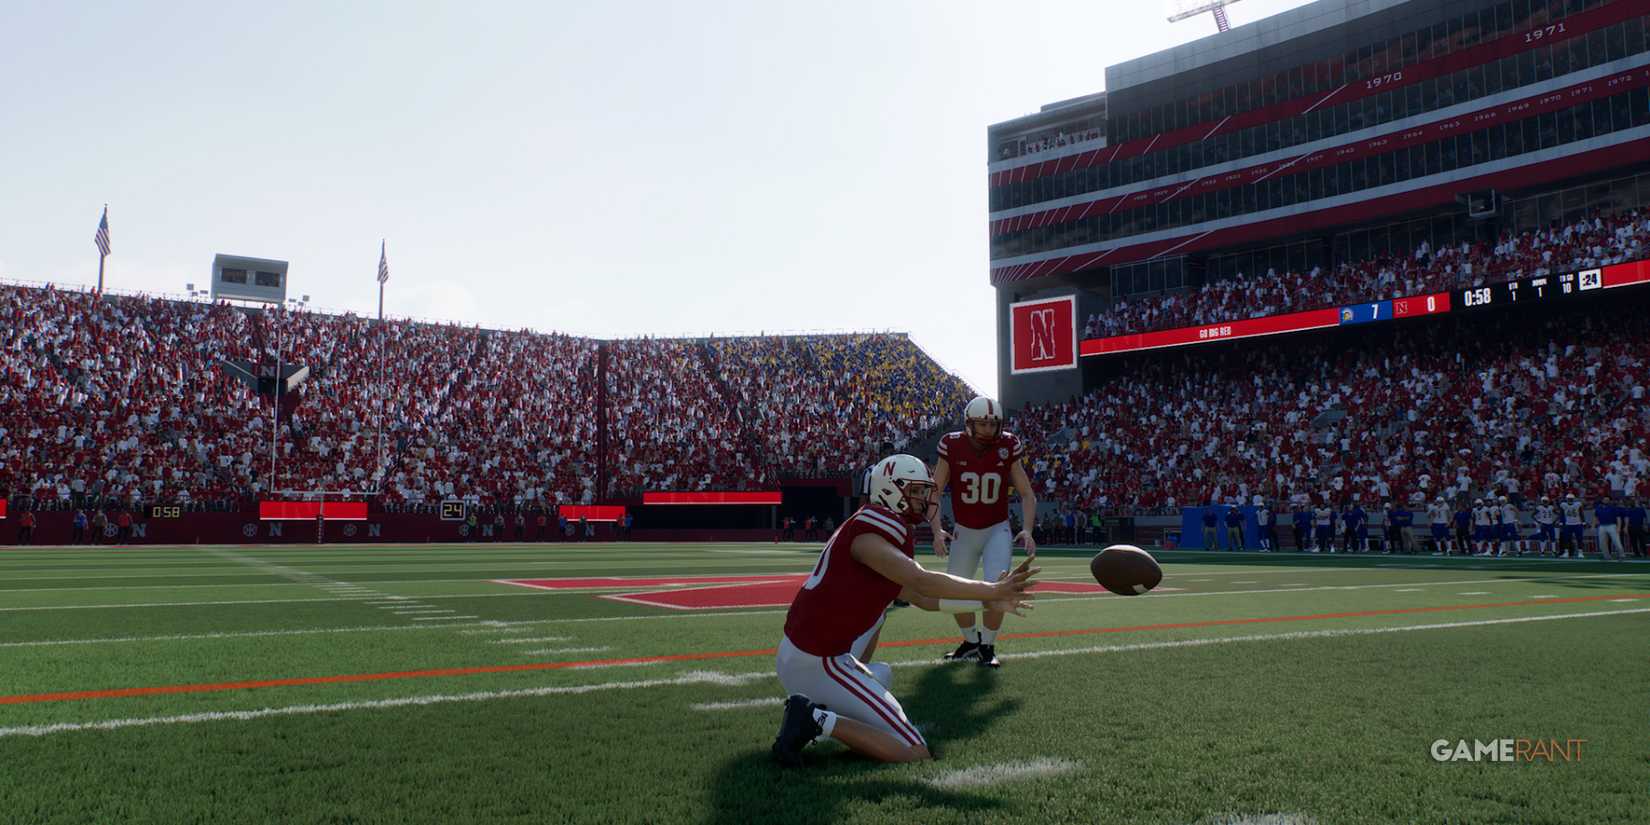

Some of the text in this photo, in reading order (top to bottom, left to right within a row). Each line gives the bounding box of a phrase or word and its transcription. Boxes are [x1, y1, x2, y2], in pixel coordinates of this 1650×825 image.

[1365, 22, 1567, 90] 1970 1971
[1582, 272, 1598, 287] :24
[1512, 290, 1516, 301] 1
[1538, 287, 1542, 297] 1
[1562, 282, 1573, 295] 10
[1427, 296, 1436, 312] 0
[1464, 287, 1491, 307] 0:58
[1371, 303, 1380, 320] 7
[1394, 301, 1408, 314] N
[1030, 308, 1057, 361] N
[883, 461, 897, 477] N
[960, 471, 1002, 505] 30
[442, 503, 463, 517] 24
[268, 523, 284, 537] N
[368, 523, 381, 537] N
